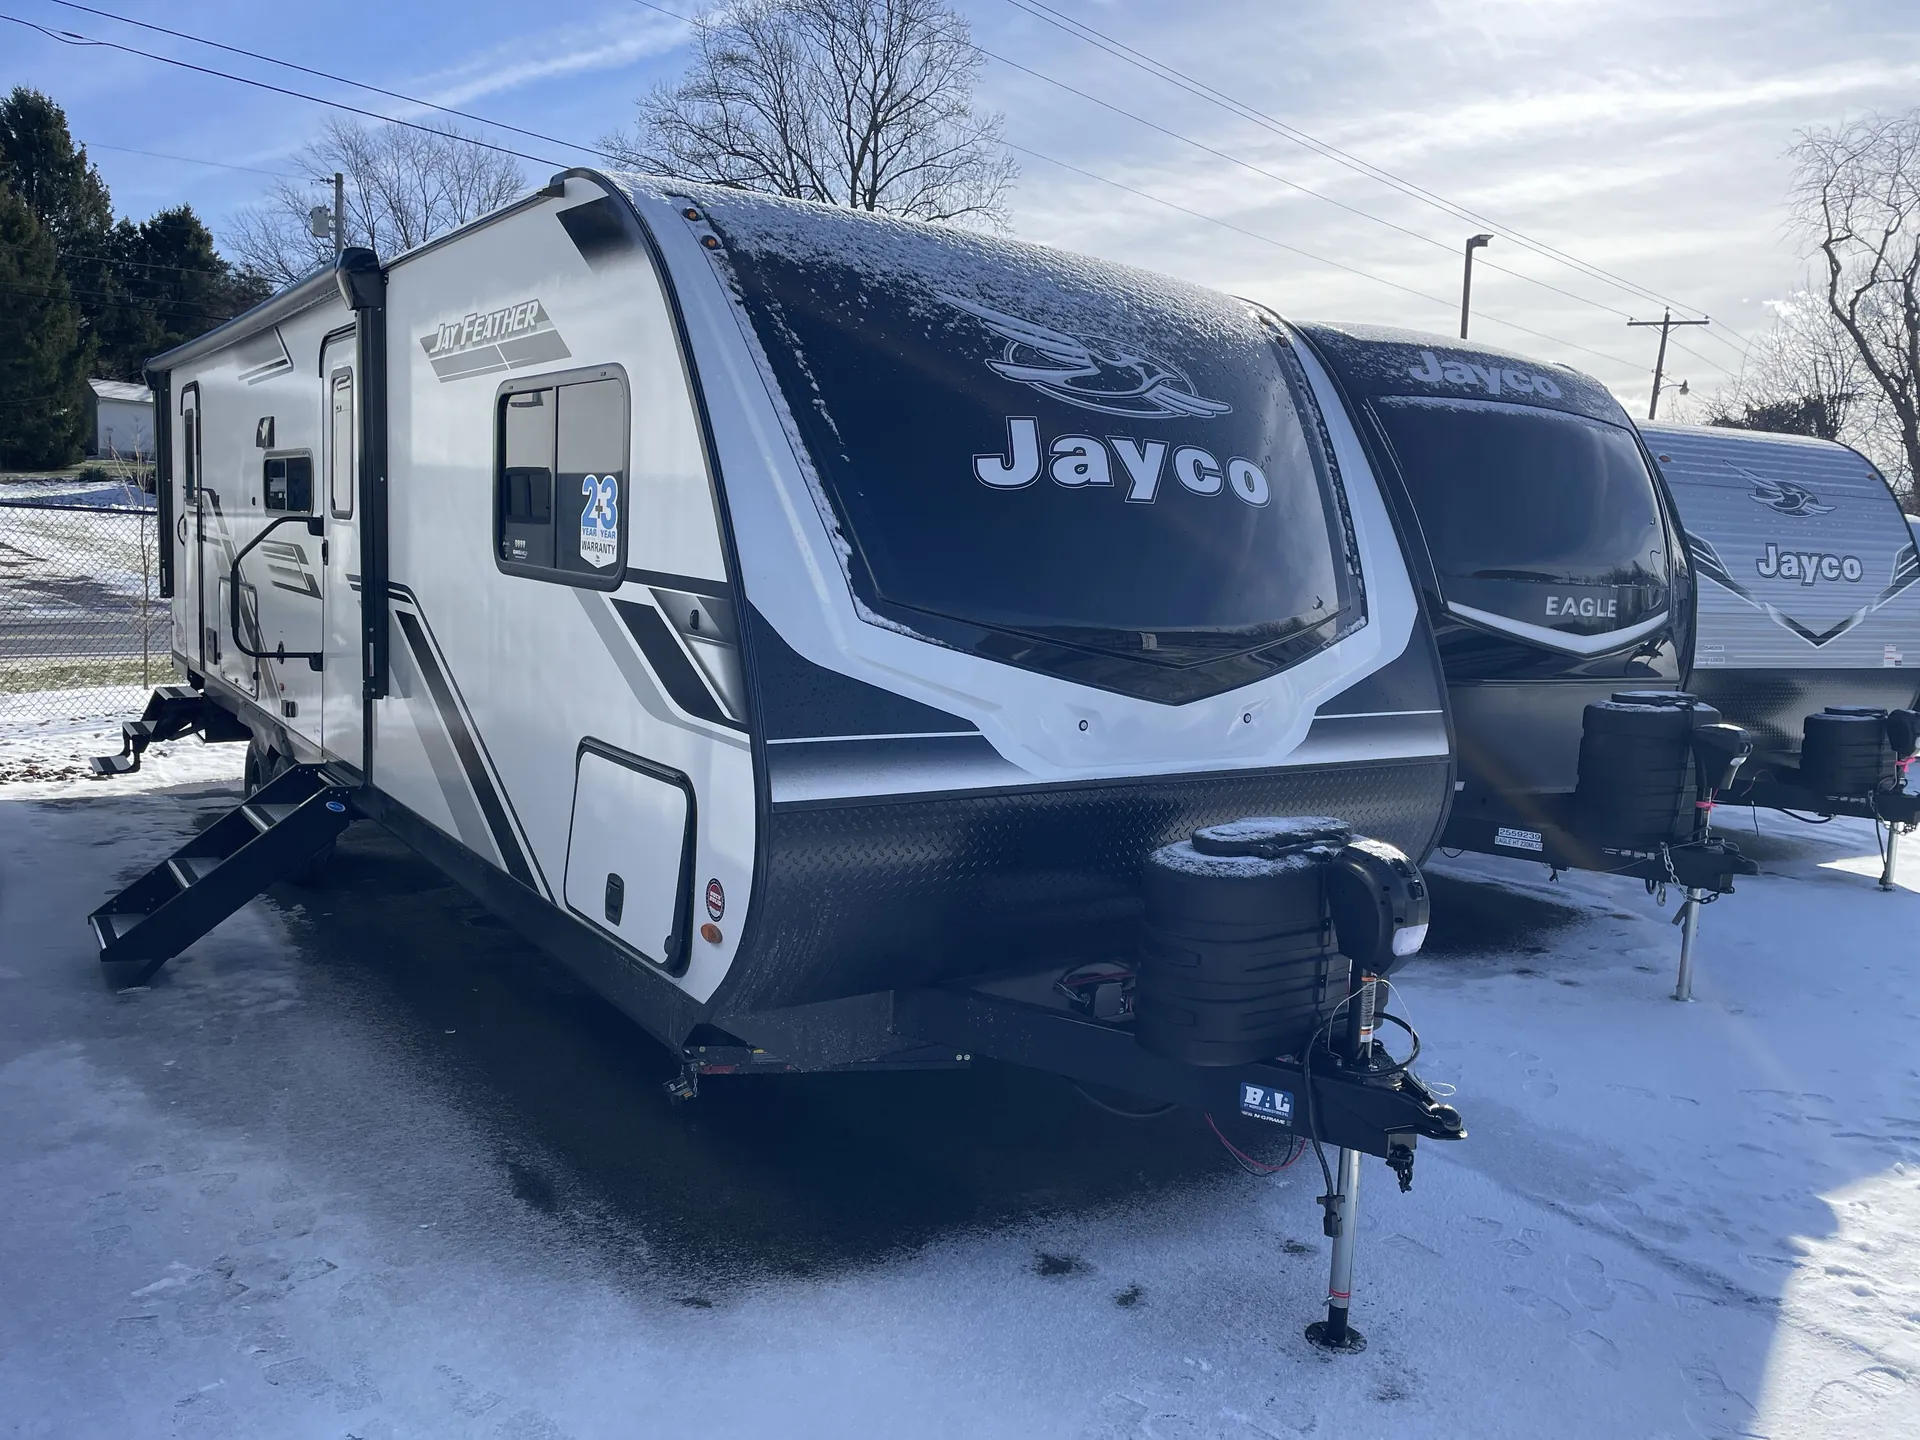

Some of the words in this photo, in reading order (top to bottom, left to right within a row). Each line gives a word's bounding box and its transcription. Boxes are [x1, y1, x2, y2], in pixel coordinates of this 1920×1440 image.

[429, 322, 461, 353] JAY
[460, 299, 540, 346] FEATHER
[1408, 351, 1563, 398] Jayco
[972, 416, 1271, 508] Jayco
[582, 527, 597, 537] YEAR
[600, 529, 616, 540] YEAR
[582, 540, 616, 555] WARRANTY
[1756, 543, 1863, 586] Jayco
[1545, 596, 1617, 617] EAGLE
[1496, 836, 1511, 845] EAGLE
[1512, 838, 1519, 846] HT
[1499, 828, 1541, 840] 2559239
[1244, 1086, 1290, 1112] BAL
